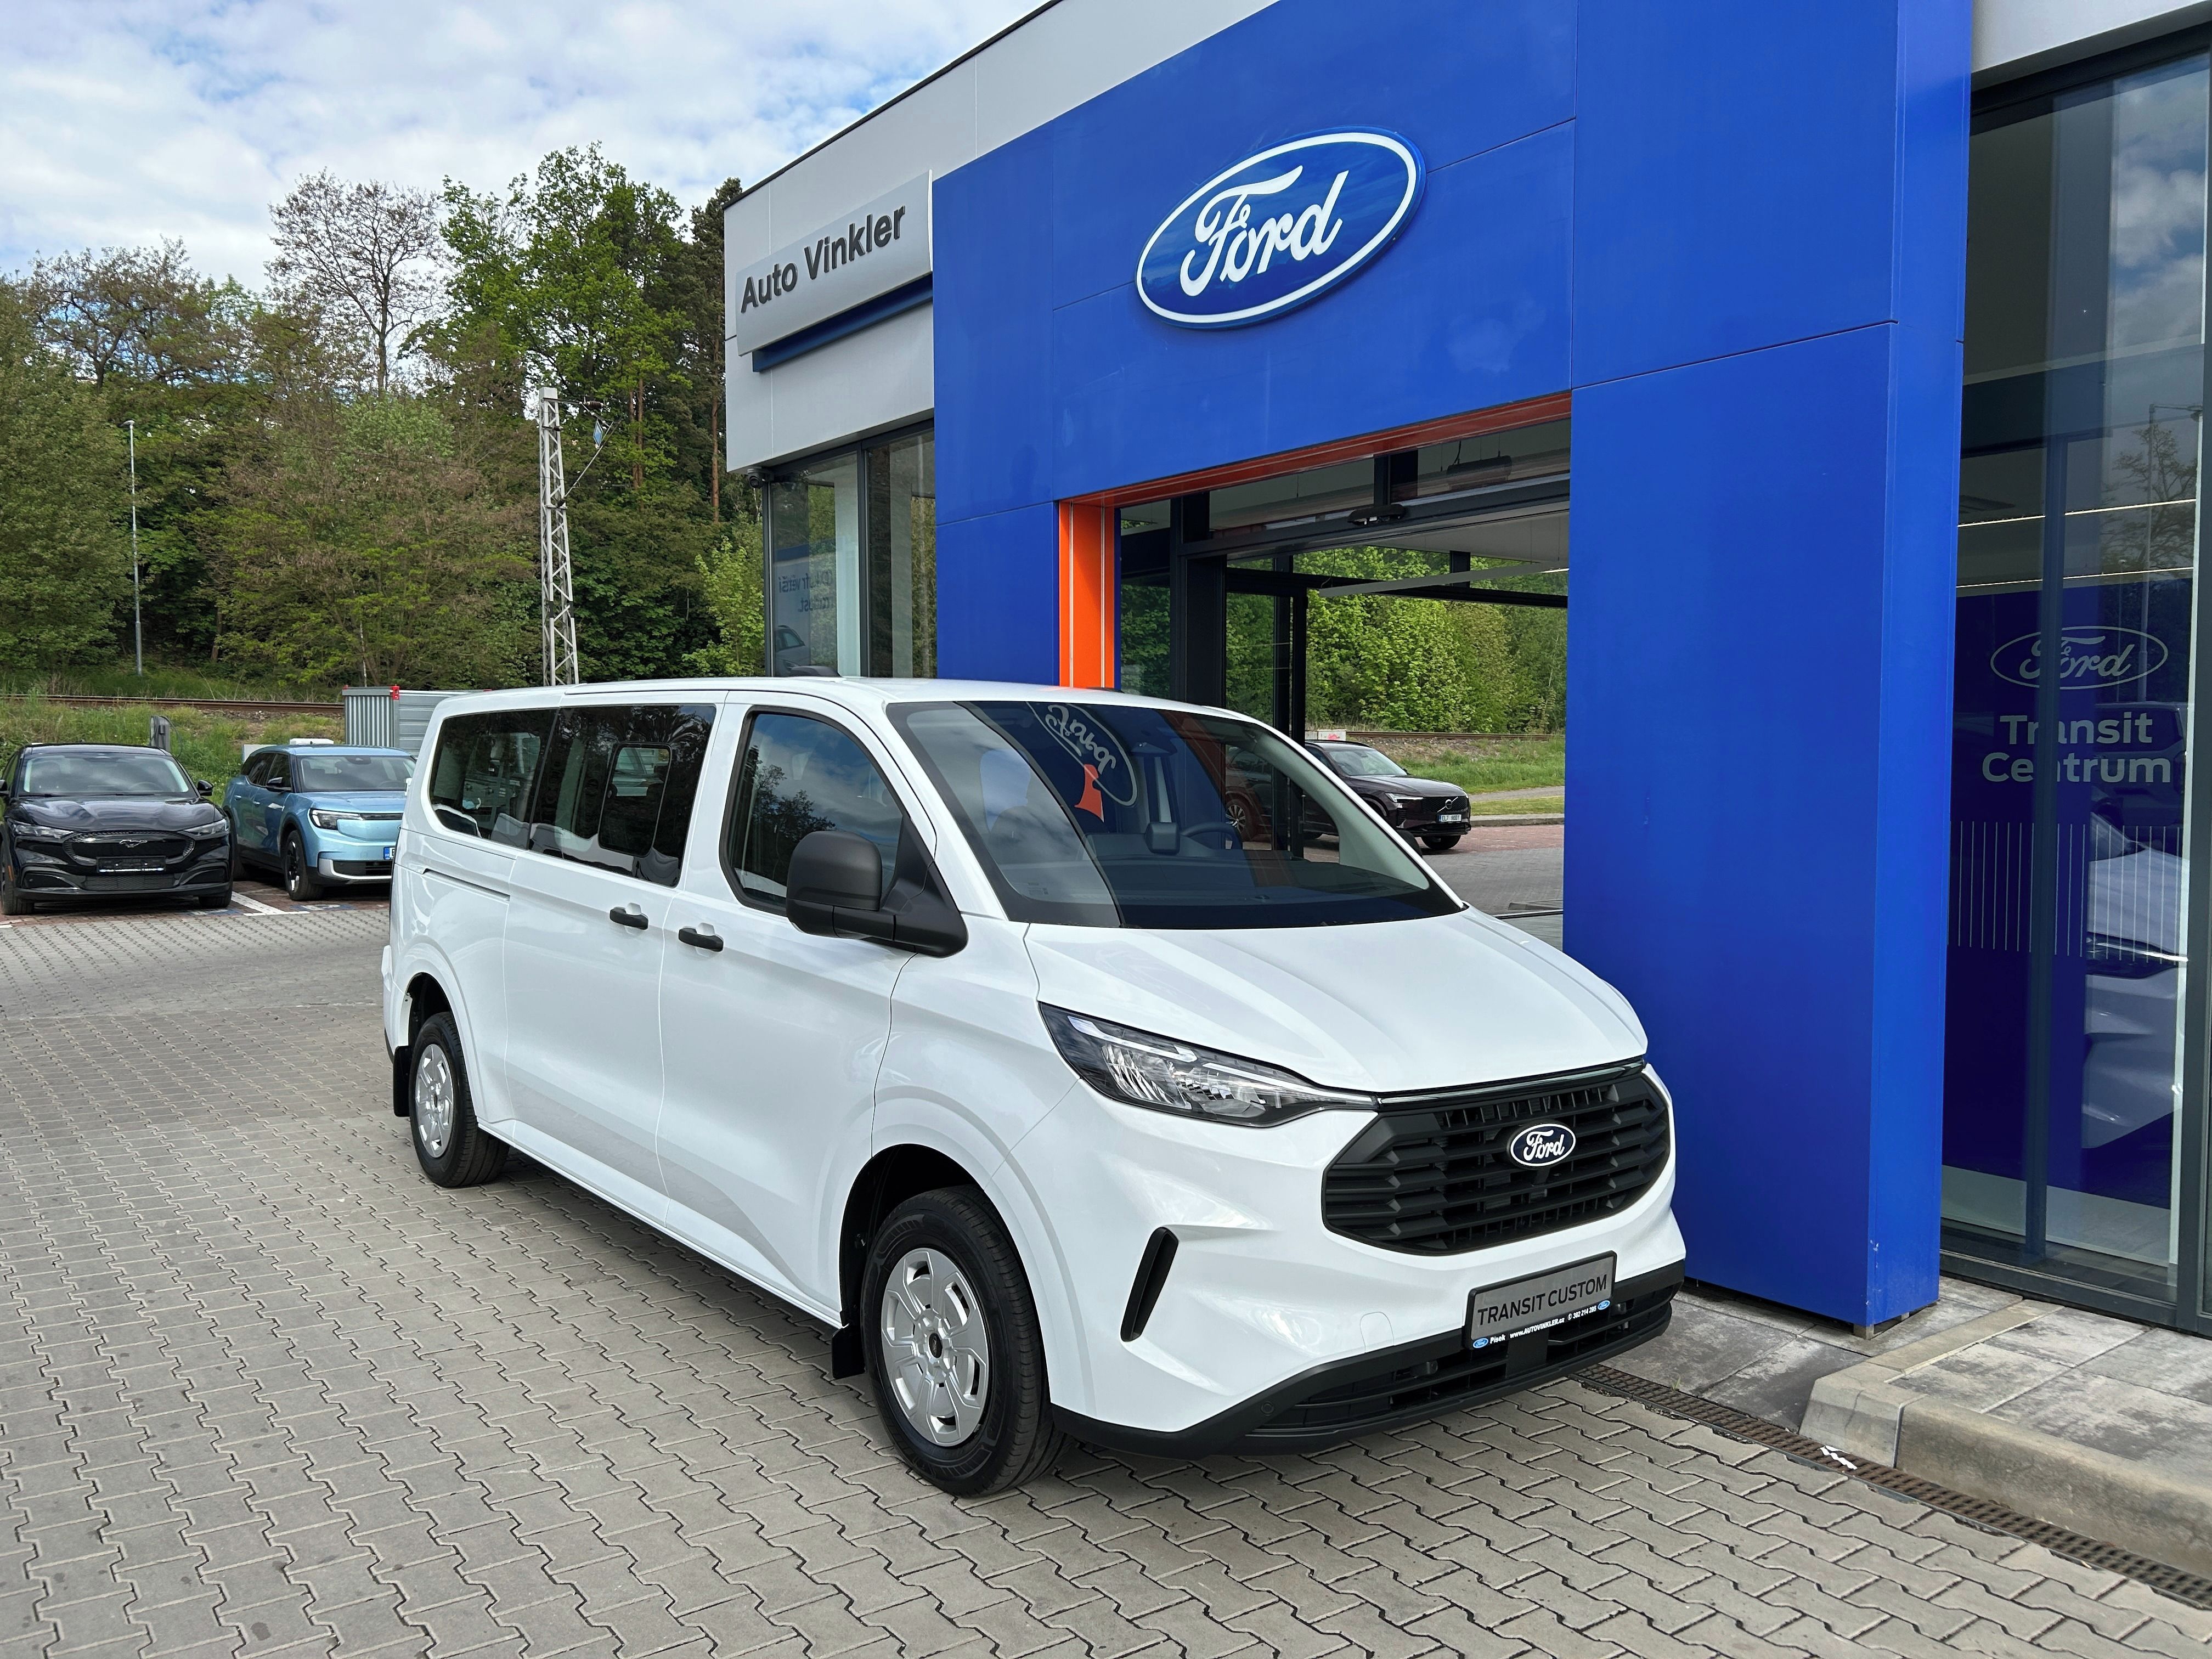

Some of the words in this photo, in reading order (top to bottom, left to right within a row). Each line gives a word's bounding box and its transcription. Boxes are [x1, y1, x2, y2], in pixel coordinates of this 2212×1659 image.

[1180, 165, 1349, 297] Ford
[741, 263, 798, 313] Auto
[804, 205, 905, 280] Vinkler
[1982, 752, 2171, 783] Cetrum
[1523, 1130, 1565, 1161] Ford
[1477, 1293, 1546, 1325] TRANSIT
[1548, 1274, 1607, 1307] CUSTOM
[1509, 1317, 1565, 1339] www.AUTOVINKLER.cz
